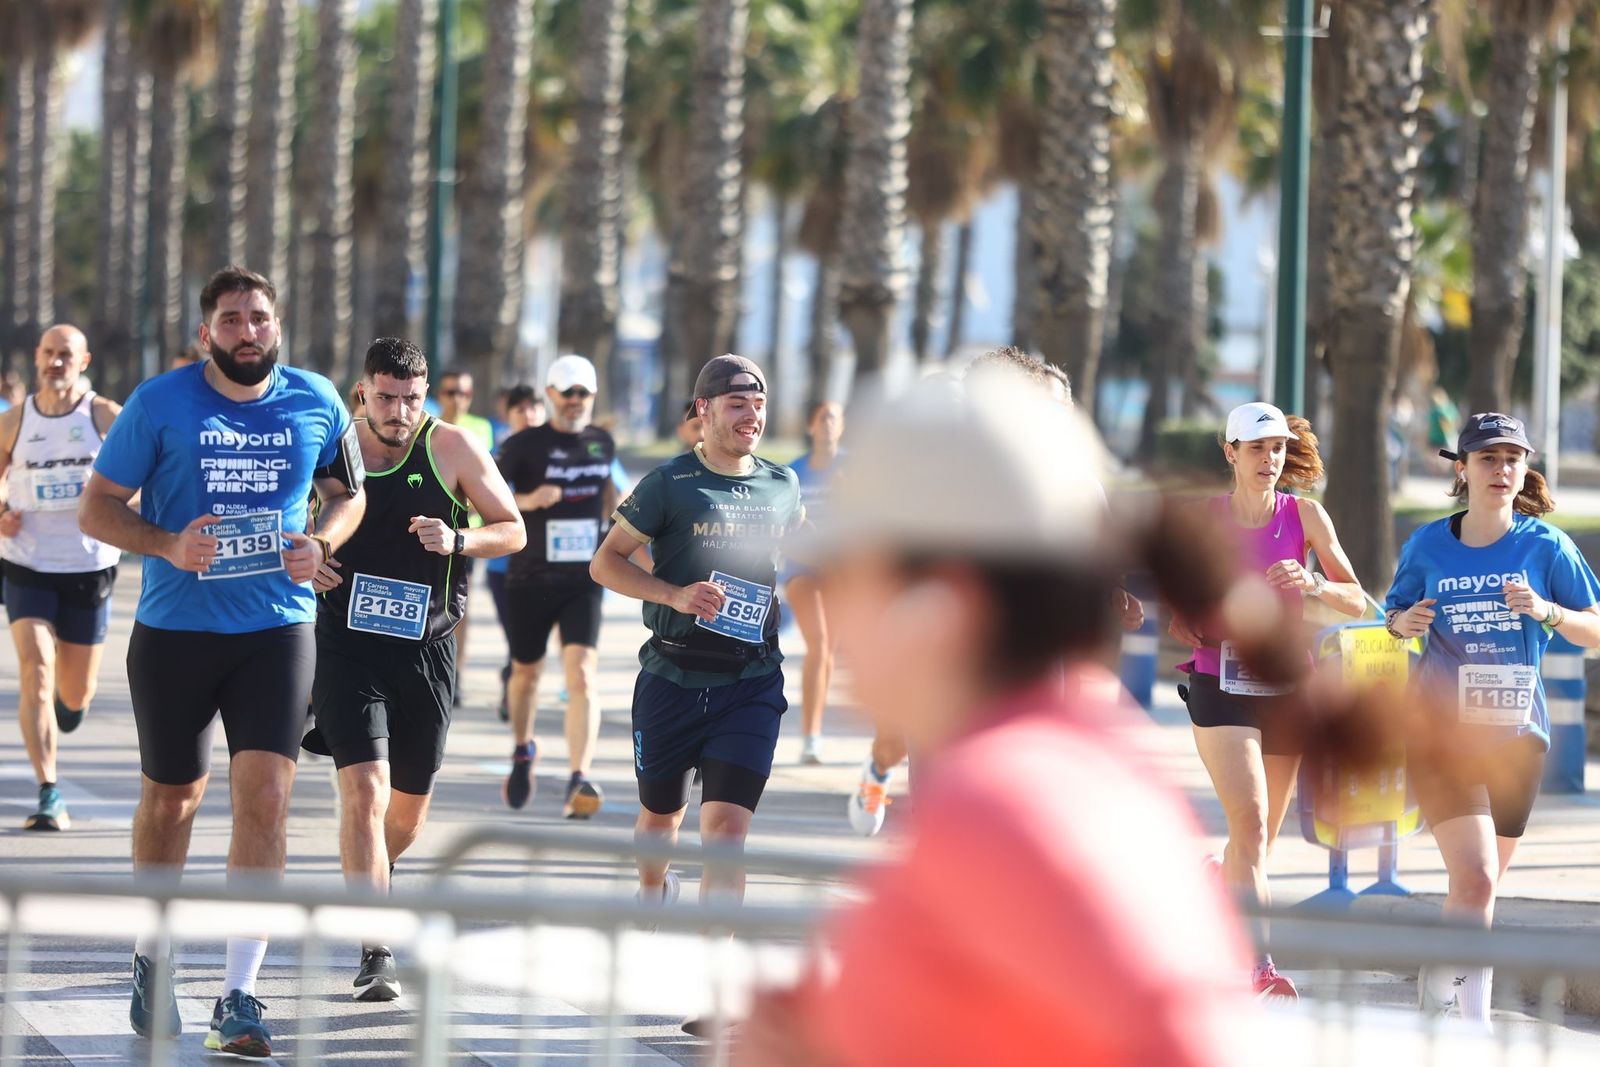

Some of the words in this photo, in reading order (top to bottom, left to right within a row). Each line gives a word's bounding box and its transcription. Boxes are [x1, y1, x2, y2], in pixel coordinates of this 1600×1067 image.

[199, 427, 292, 451] mayoral
[201, 458, 287, 470] RUNNING
[209, 470, 279, 481] MAKES
[43, 484, 78, 499] 639
[206, 482, 279, 493] FRIENDS
[709, 503, 741, 512] SIERRA
[744, 505, 777, 513] BLANCA
[725, 511, 763, 520] ESTATES
[702, 540, 727, 550] HALF
[359, 596, 418, 620] 2138
[1452, 621, 1522, 634] FRIENDS
[1471, 689, 1529, 708] 1186
[635, 730, 643, 771] FILA
